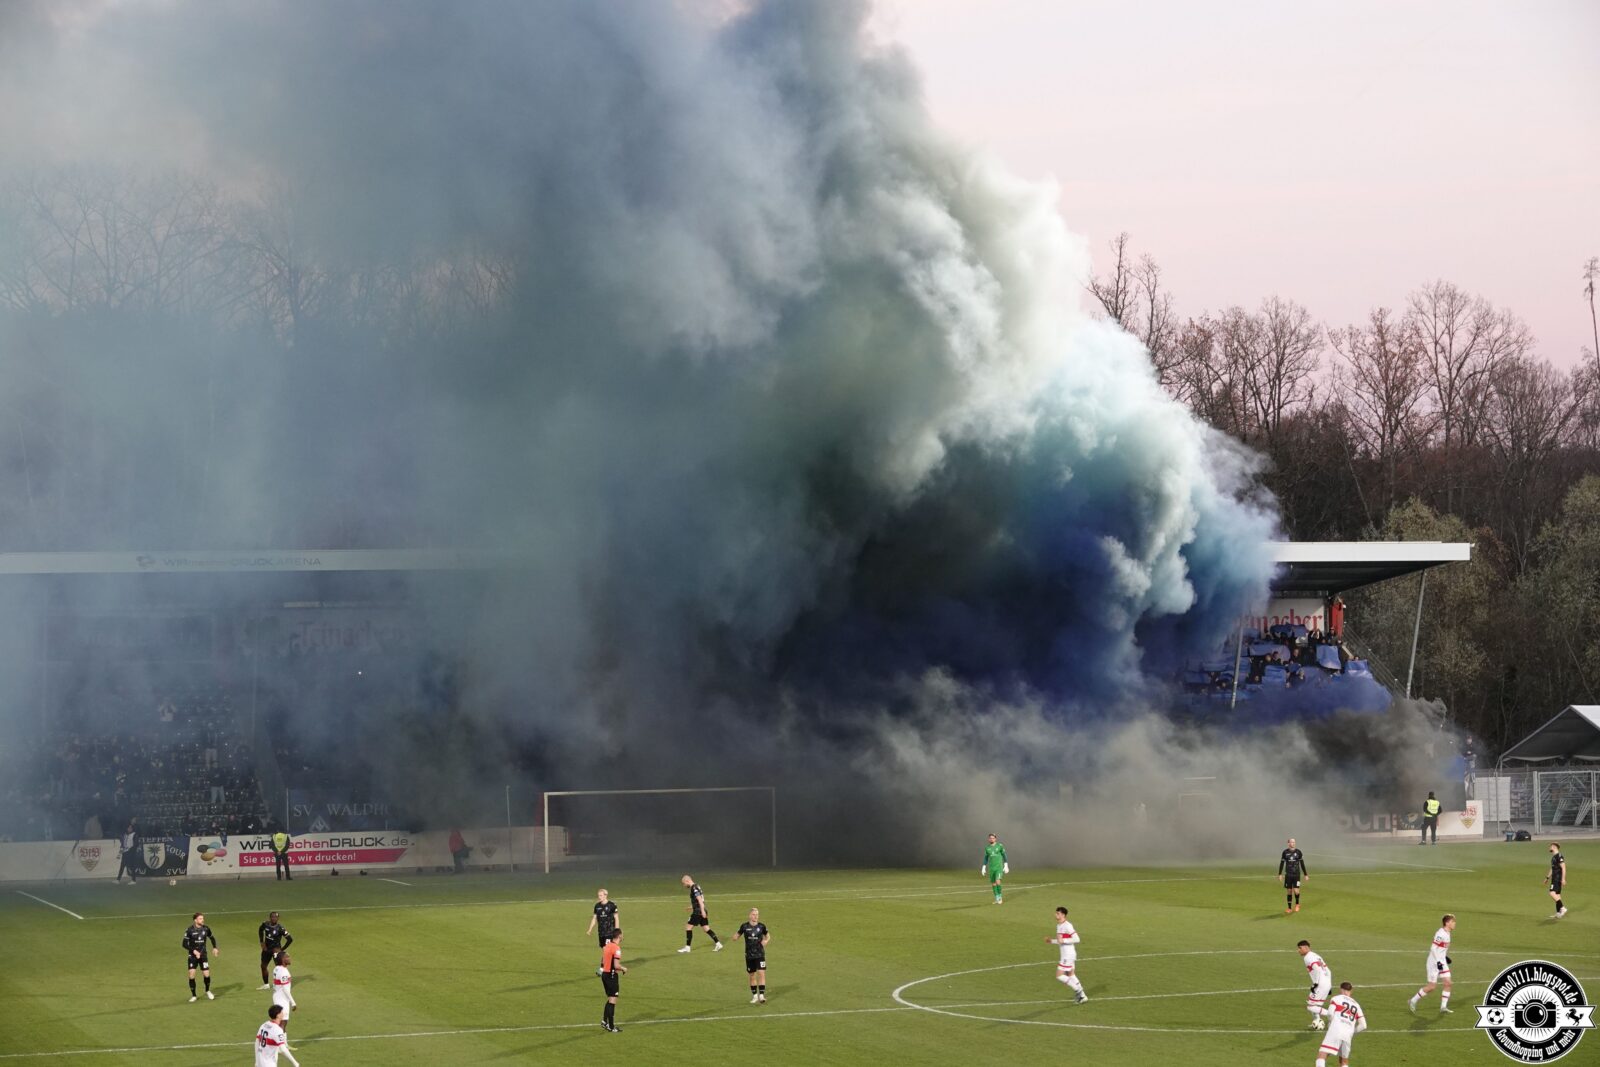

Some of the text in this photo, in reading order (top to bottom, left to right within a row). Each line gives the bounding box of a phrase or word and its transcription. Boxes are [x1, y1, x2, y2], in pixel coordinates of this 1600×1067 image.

[293, 804, 313, 817] SV
[239, 835, 408, 851] WIRachenDRUCK.de
[165, 844, 186, 860] TOUR
[243, 852, 356, 865] Sie span, wir drucken!
[1340, 1001, 1358, 1022] 29
[260, 1029, 269, 1048] 16
